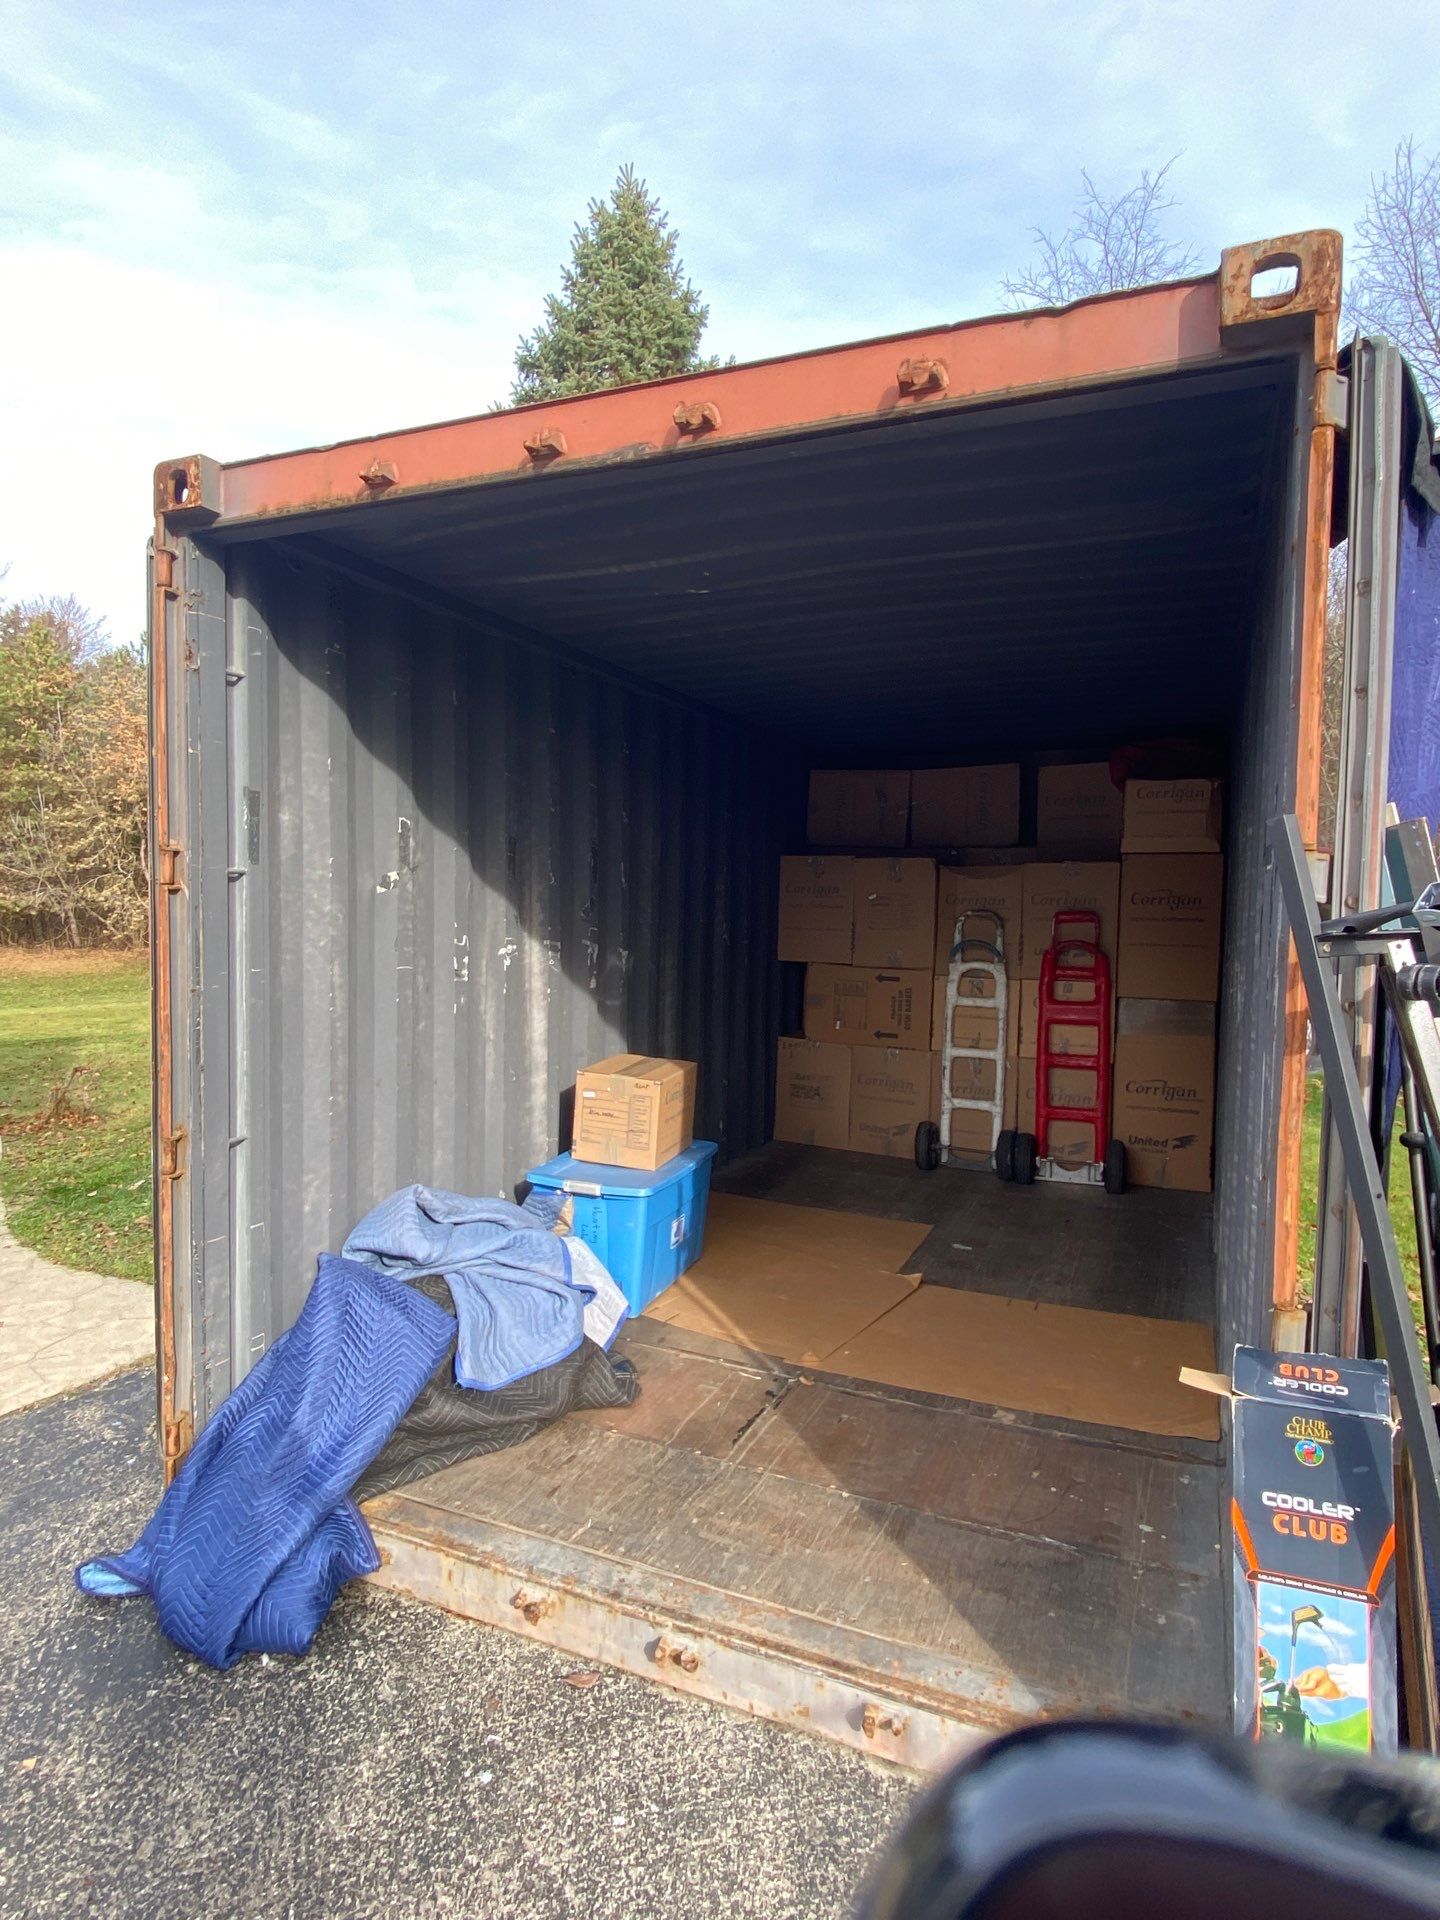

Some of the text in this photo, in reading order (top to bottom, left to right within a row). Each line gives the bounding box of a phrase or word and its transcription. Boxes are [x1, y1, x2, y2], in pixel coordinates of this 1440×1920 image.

[1136, 784, 1205, 804] Corrigan
[1131, 888, 1202, 911] Corrigan
[857, 1073, 914, 1092] Corrigan
[1126, 1079, 1198, 1101] Corrigan
[1128, 1135, 1169, 1148] United
[1279, 1363, 1339, 1382] CLUB
[1273, 1376, 1349, 1396] COOLER
[1286, 1423, 1332, 1439] CHAMP
[1292, 1415, 1325, 1430] CLUB
[1261, 1490, 1355, 1521] COOLER
[1272, 1513, 1348, 1544] CLUB
